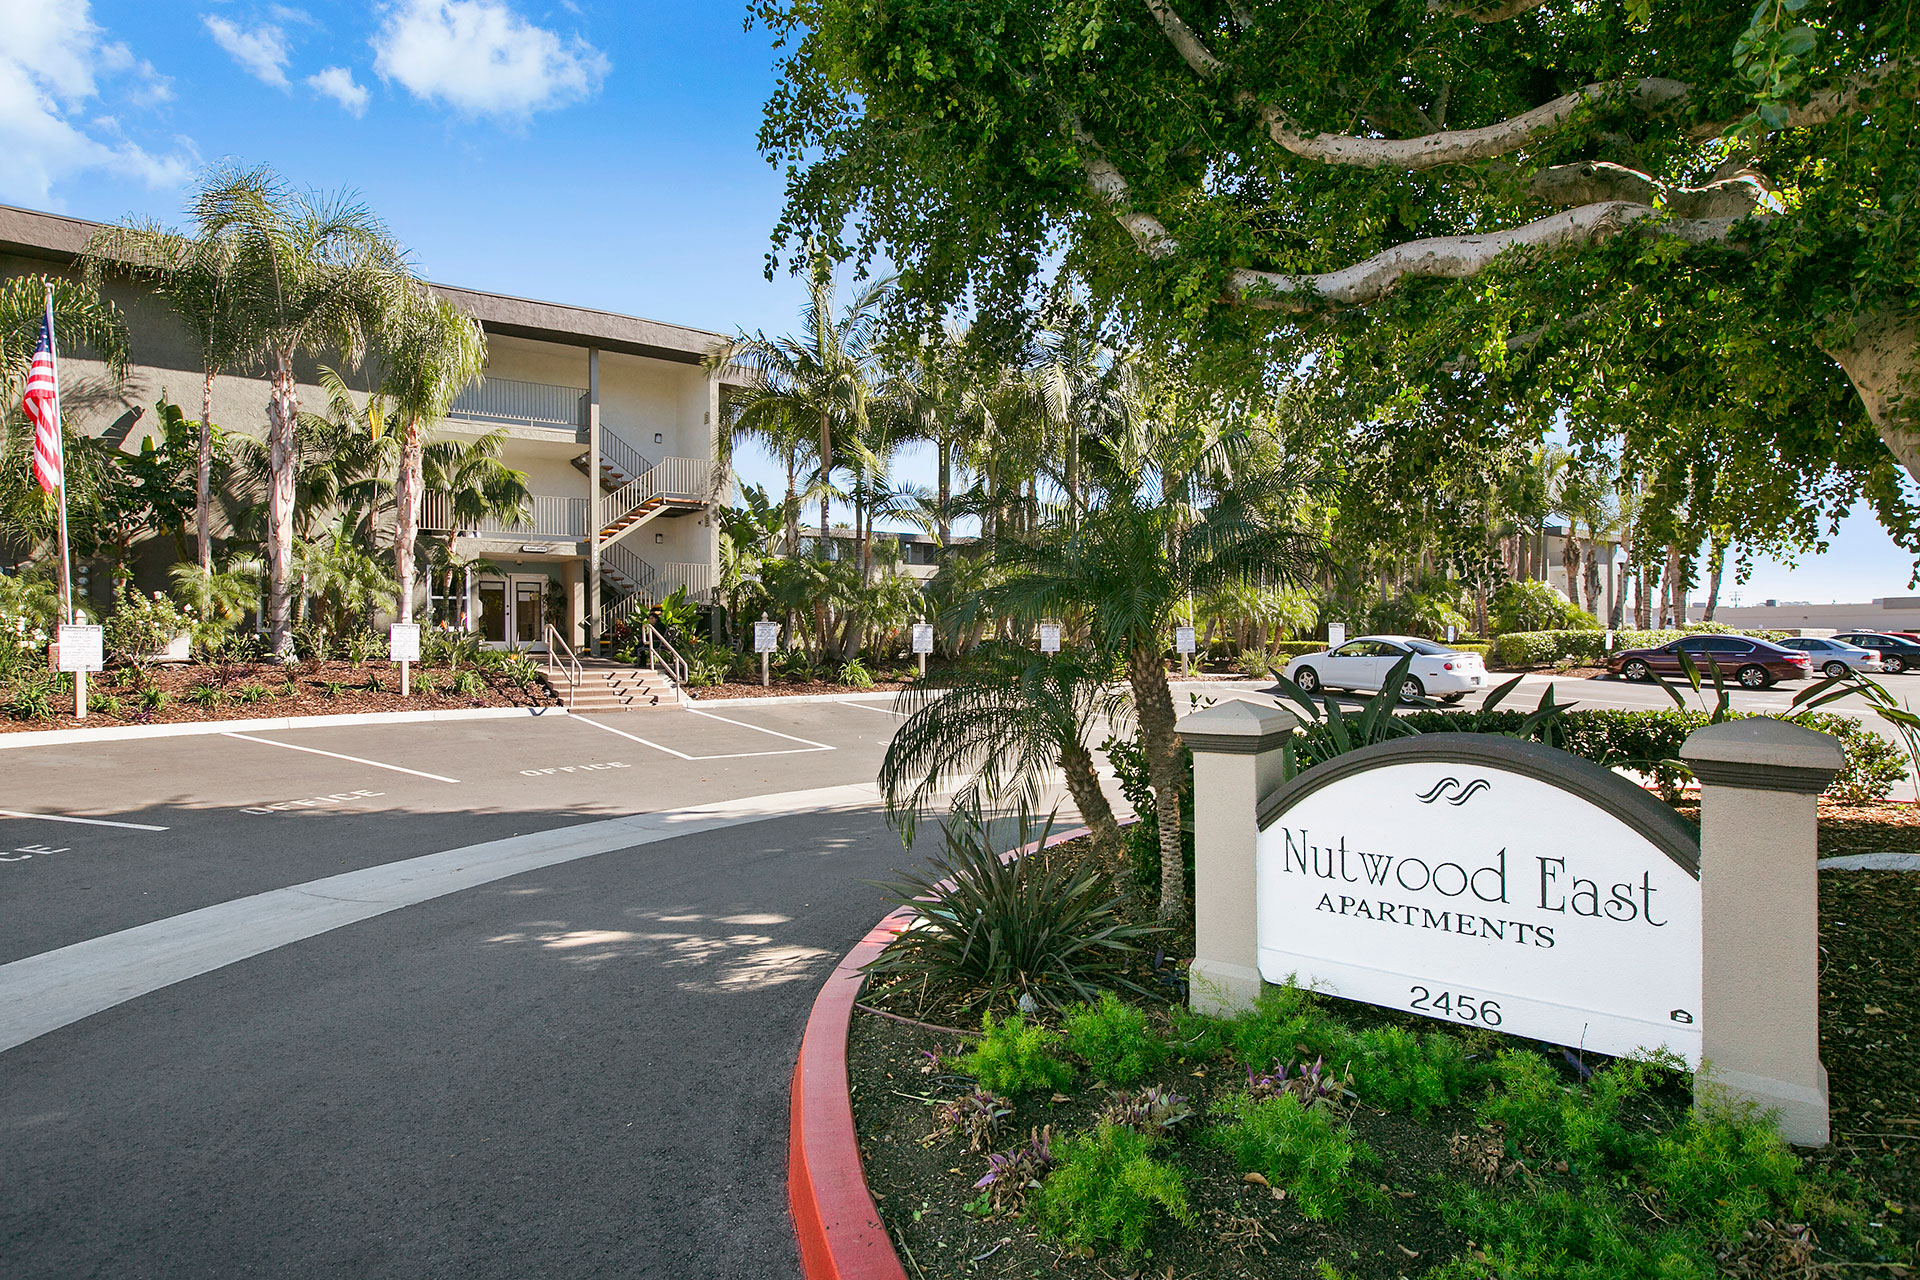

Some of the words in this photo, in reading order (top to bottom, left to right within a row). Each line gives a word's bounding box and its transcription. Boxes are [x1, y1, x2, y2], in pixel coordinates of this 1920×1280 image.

[519, 761, 631, 776] OFFICE
[239, 789, 386, 815] OFFICE
[1281, 827, 1511, 905] Nutwood
[1535, 856, 1668, 927] East
[1315, 892, 1555, 949] APARTMENTS
[1410, 985, 1503, 1027] 2456
